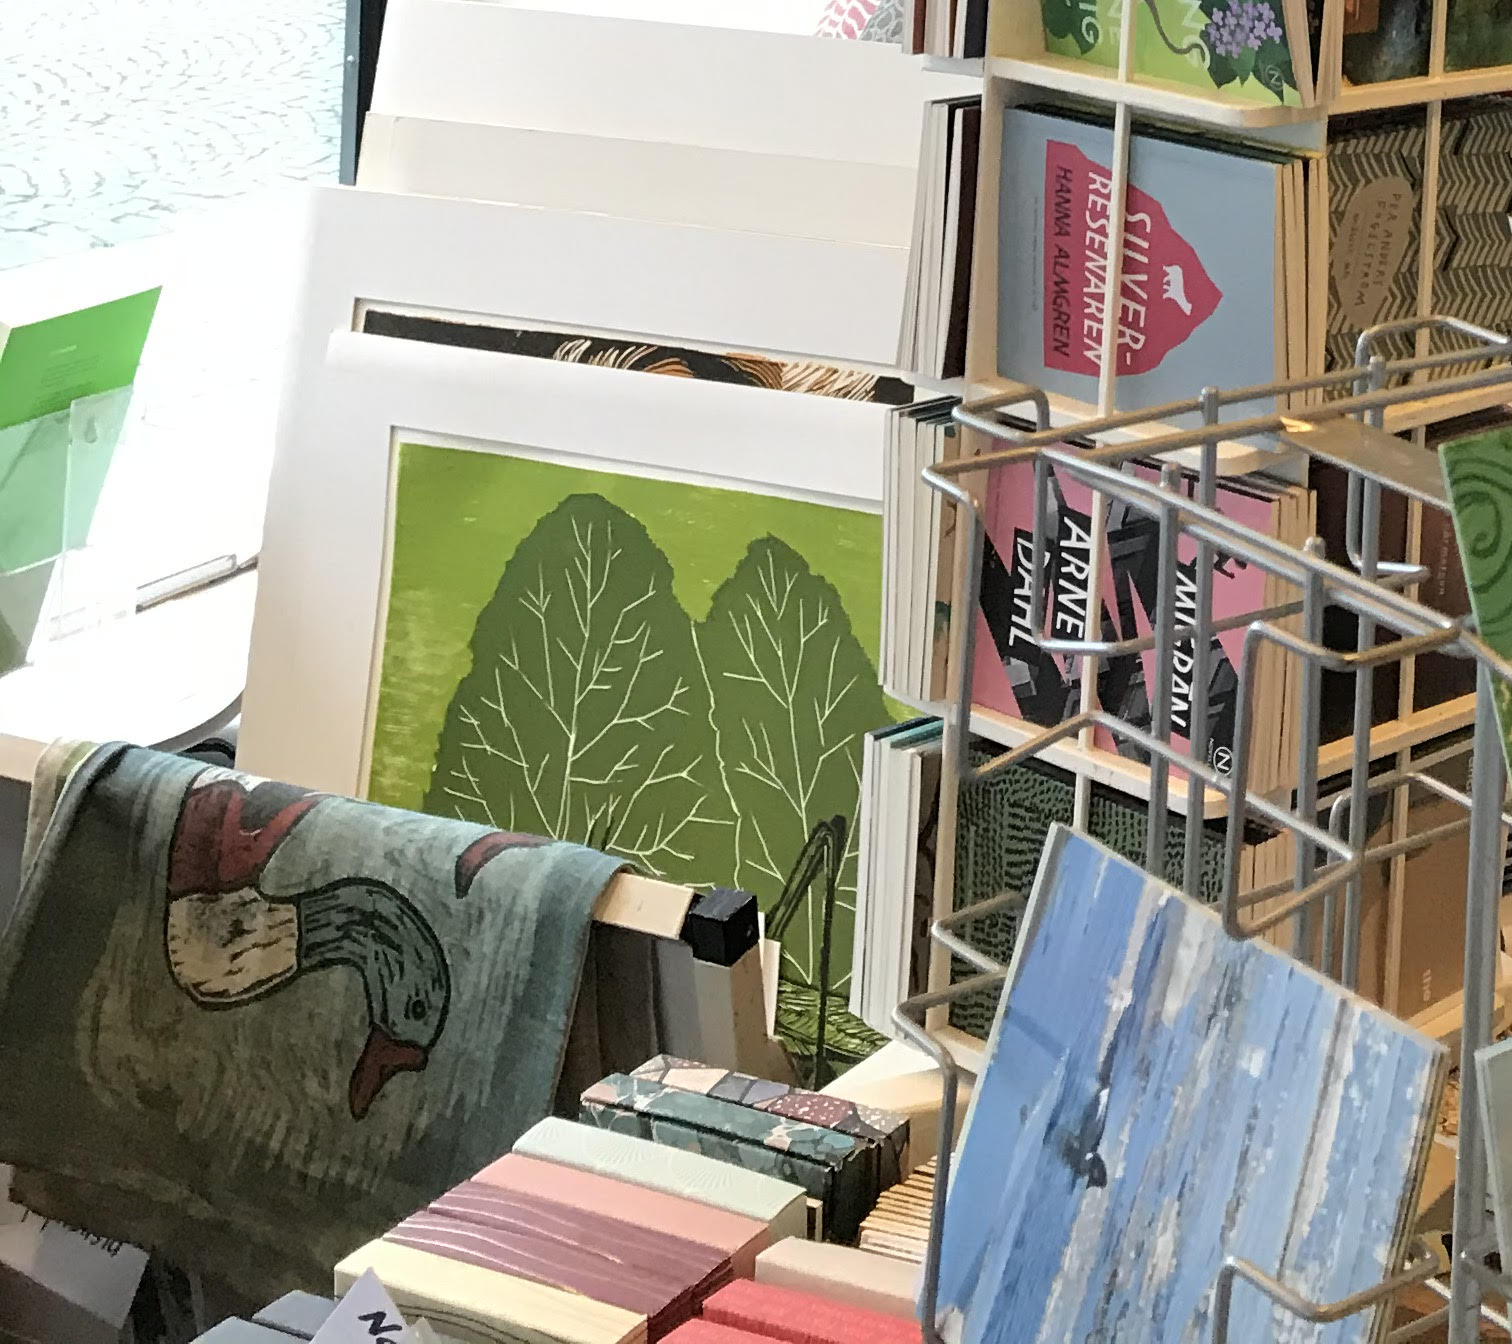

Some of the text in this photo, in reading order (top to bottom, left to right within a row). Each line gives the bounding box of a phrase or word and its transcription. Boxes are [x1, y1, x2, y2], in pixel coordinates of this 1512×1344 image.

[1051, 165, 1073, 357] HANNA ALMGREN
[1082, 171, 1112, 366] RESENAREN
[1008, 536, 1050, 647] DAHL
[1055, 516, 1092, 639] ARNE
